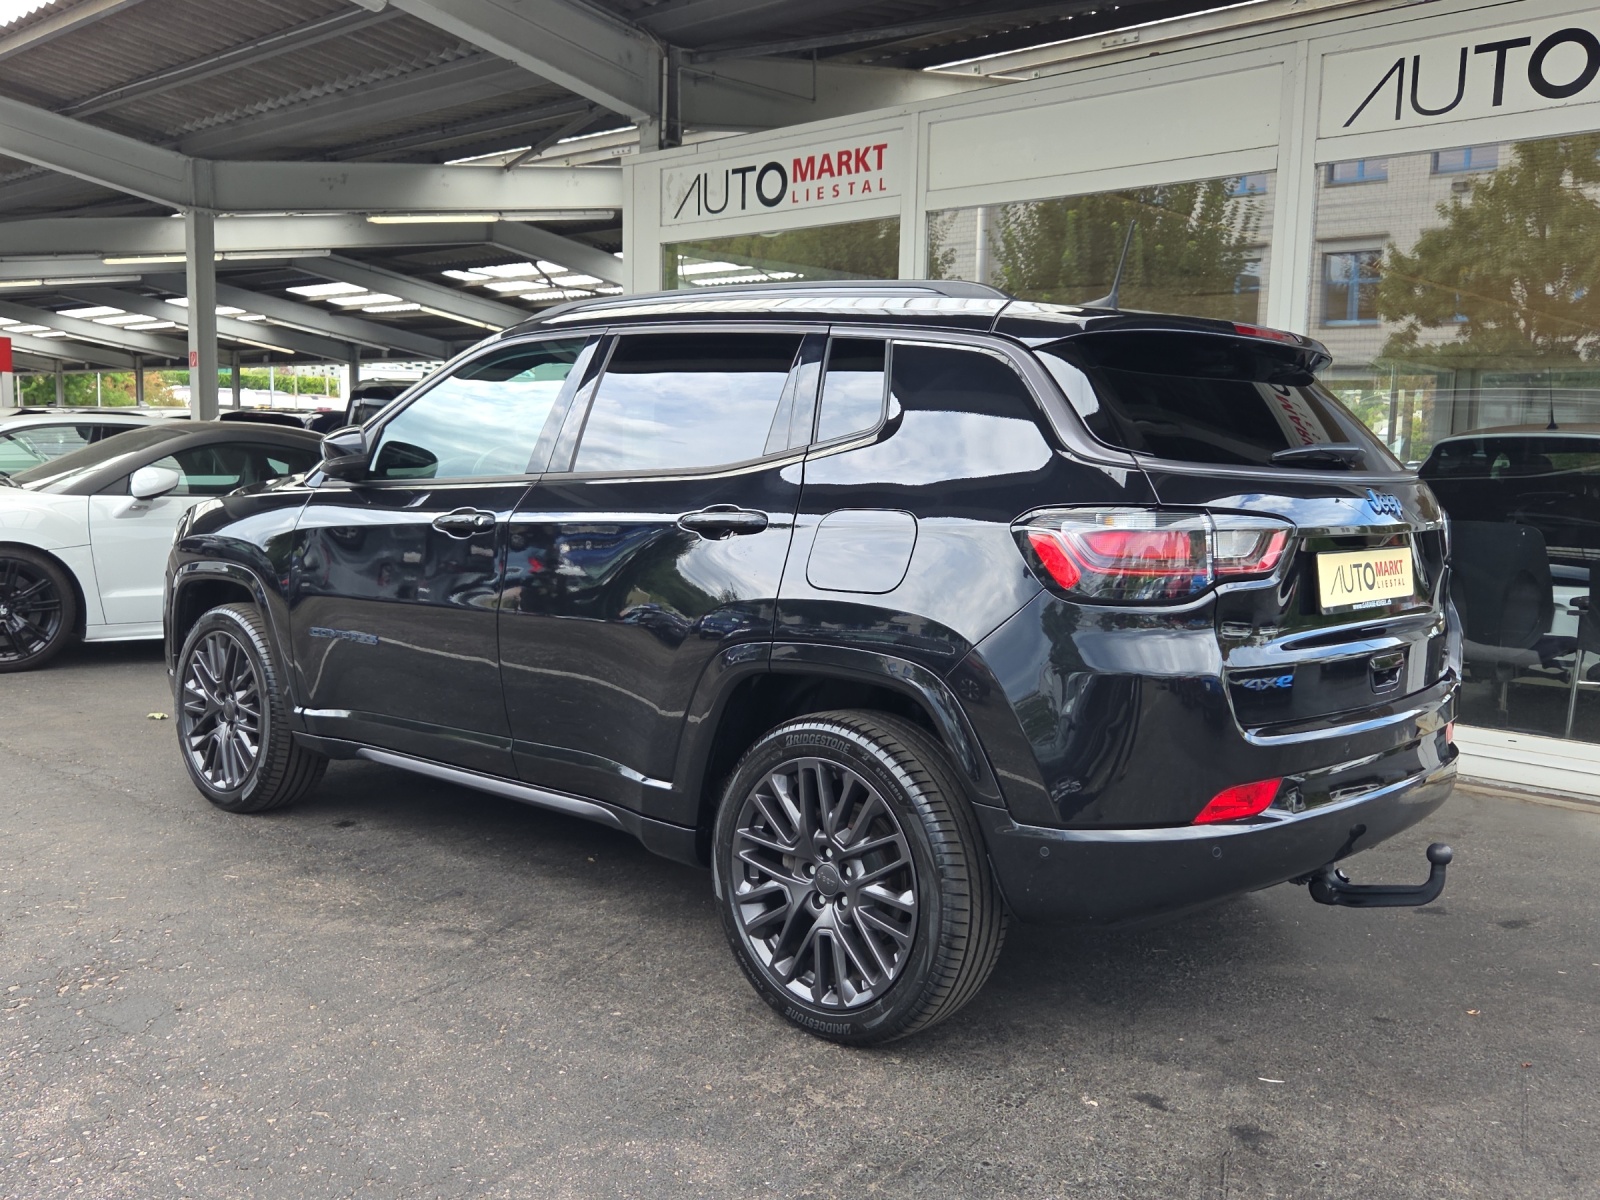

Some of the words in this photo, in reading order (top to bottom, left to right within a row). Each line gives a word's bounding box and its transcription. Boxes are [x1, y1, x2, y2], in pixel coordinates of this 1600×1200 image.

[1342, 27, 1600, 128] AUTO
[673, 161, 788, 220] AUTO
[792, 143, 888, 184] MARKT
[792, 178, 887, 204] LIESTAL
[1366, 488, 1404, 519] Jeep
[1331, 562, 1375, 595] AUTO
[1375, 560, 1403, 577] MARKT
[1377, 578, 1405, 588] LIESTAL
[1243, 674, 1294, 691] 4xe
[785, 733, 852, 754] BRIDGESTONE
[785, 1005, 851, 1035] BRIDGESTONE
